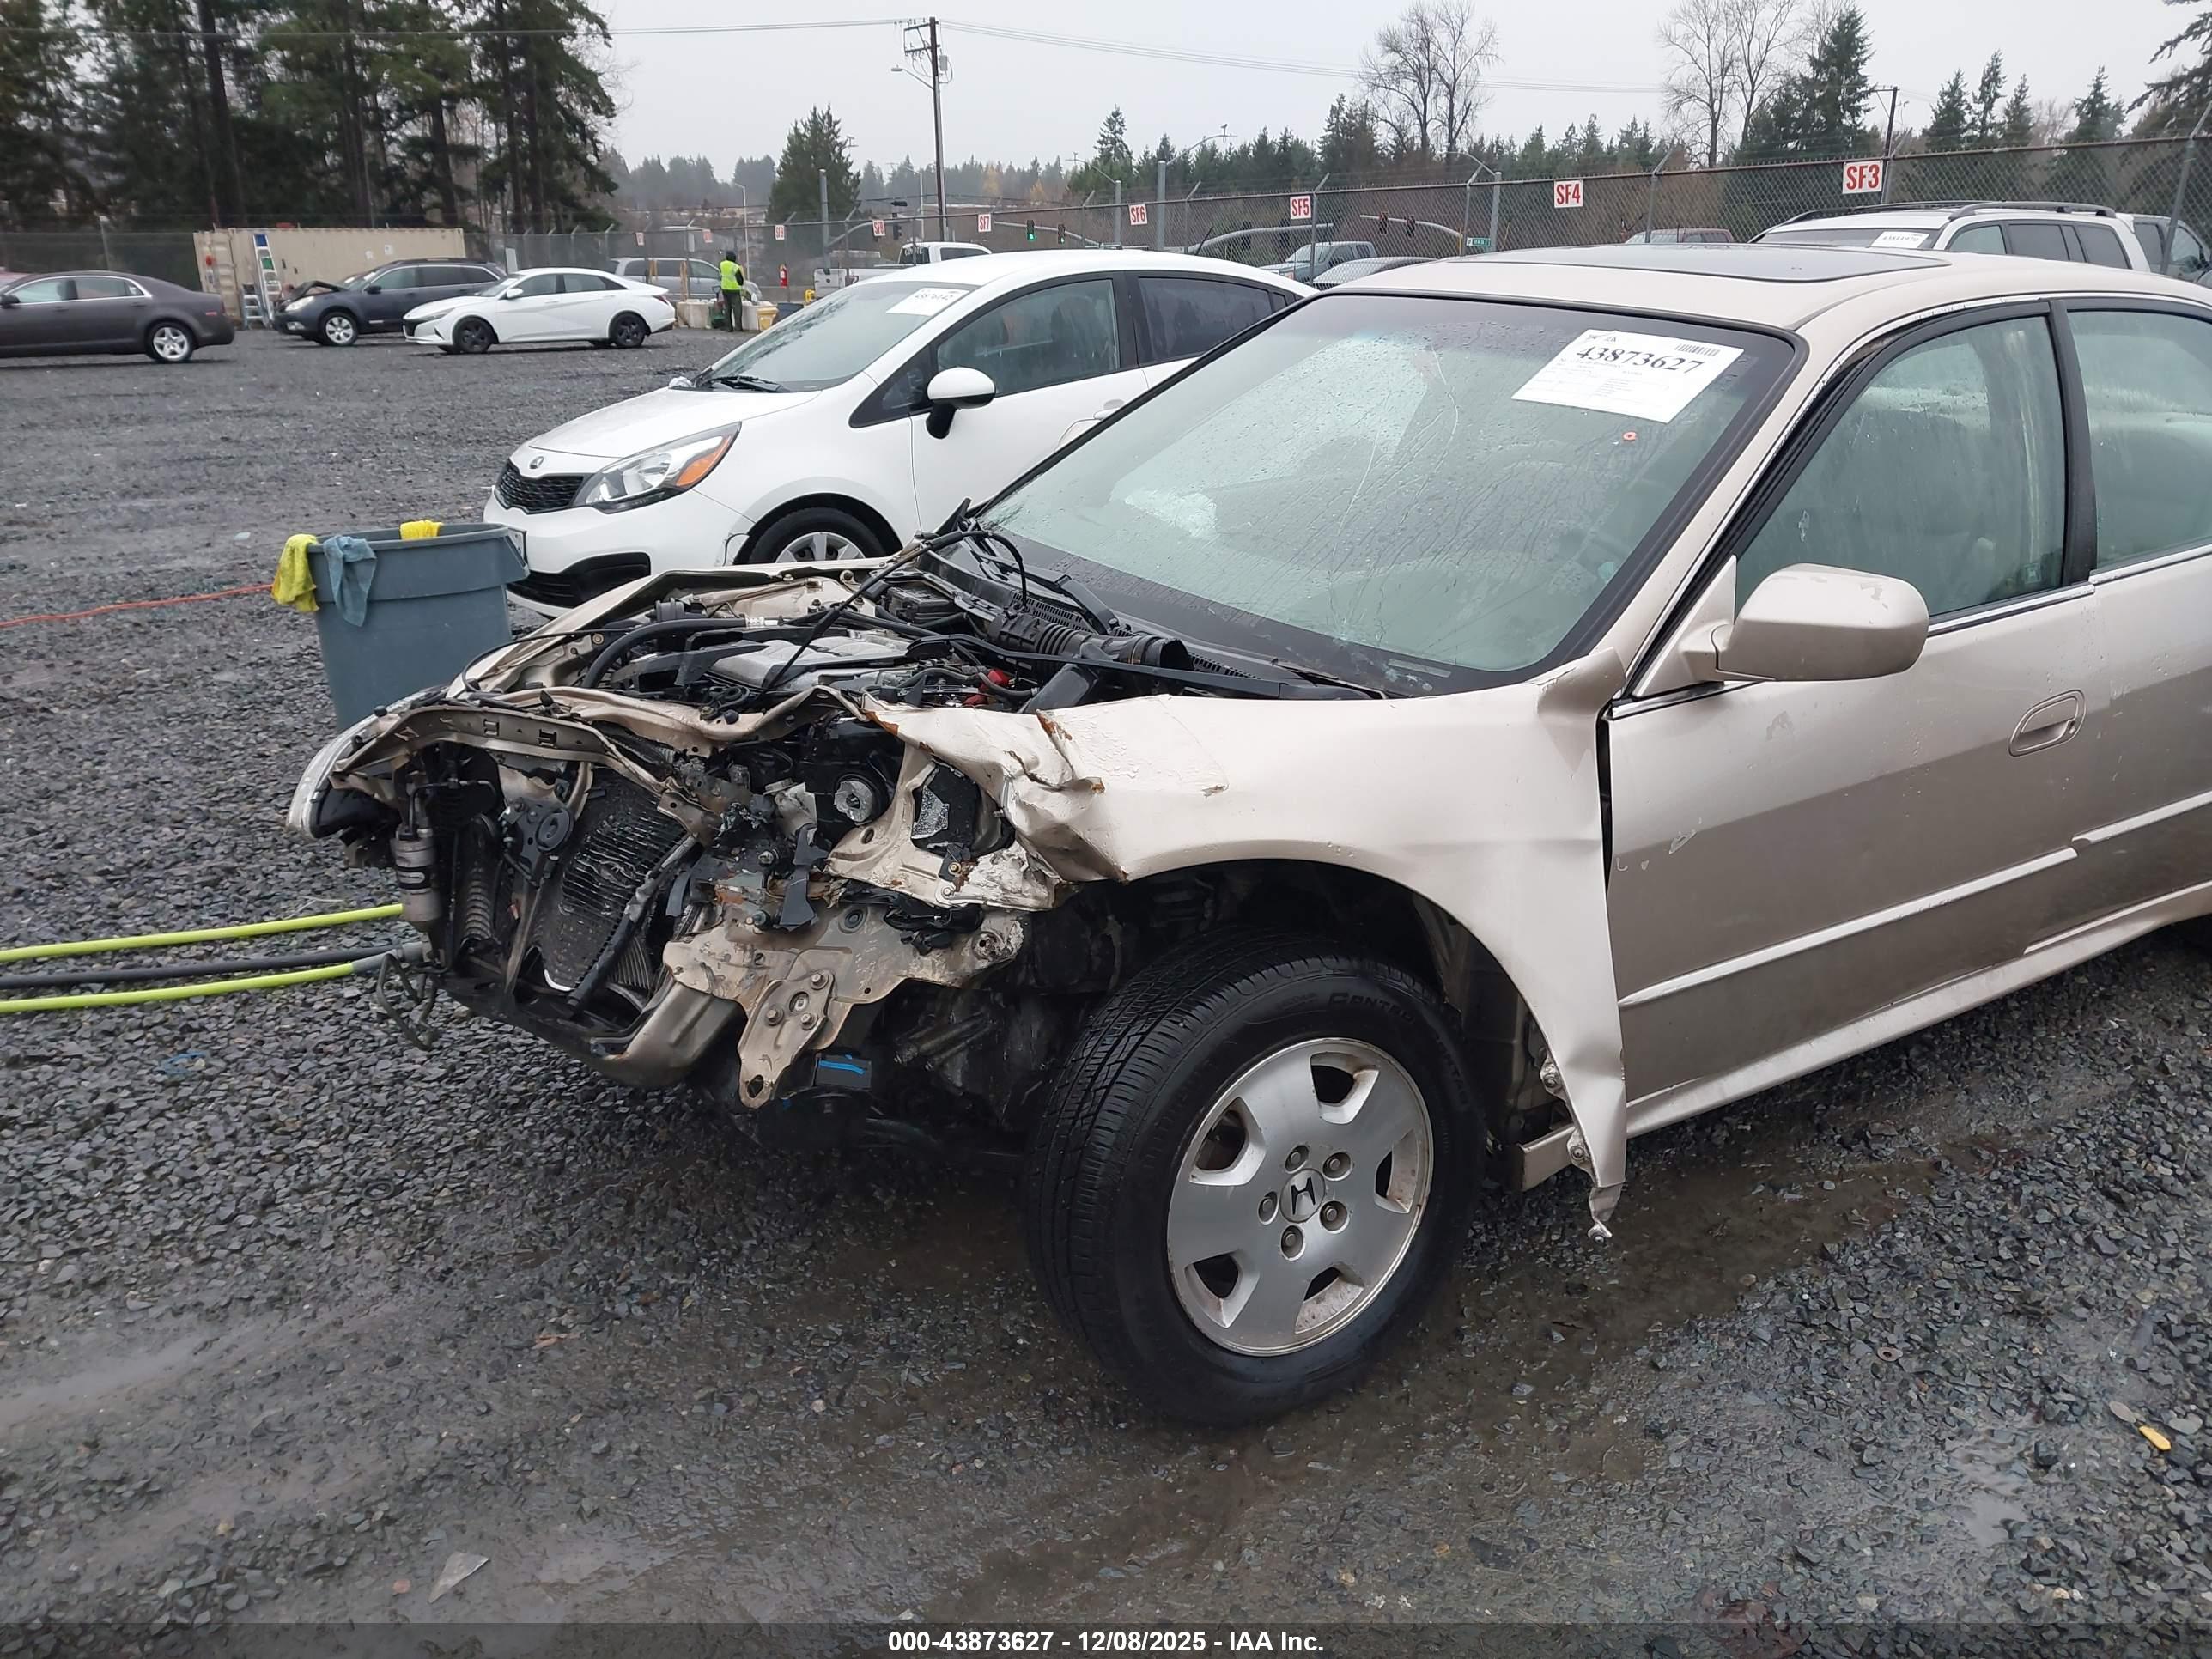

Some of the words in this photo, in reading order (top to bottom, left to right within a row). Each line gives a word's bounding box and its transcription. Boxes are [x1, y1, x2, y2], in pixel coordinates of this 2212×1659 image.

[1846, 164, 1880, 190] SF3
[1556, 183, 1581, 204] SF4
[1130, 206, 1146, 222] SF6
[1291, 198, 1310, 216] SF5
[979, 216, 989, 230] SF7
[1576, 346, 1705, 374] 43873627
